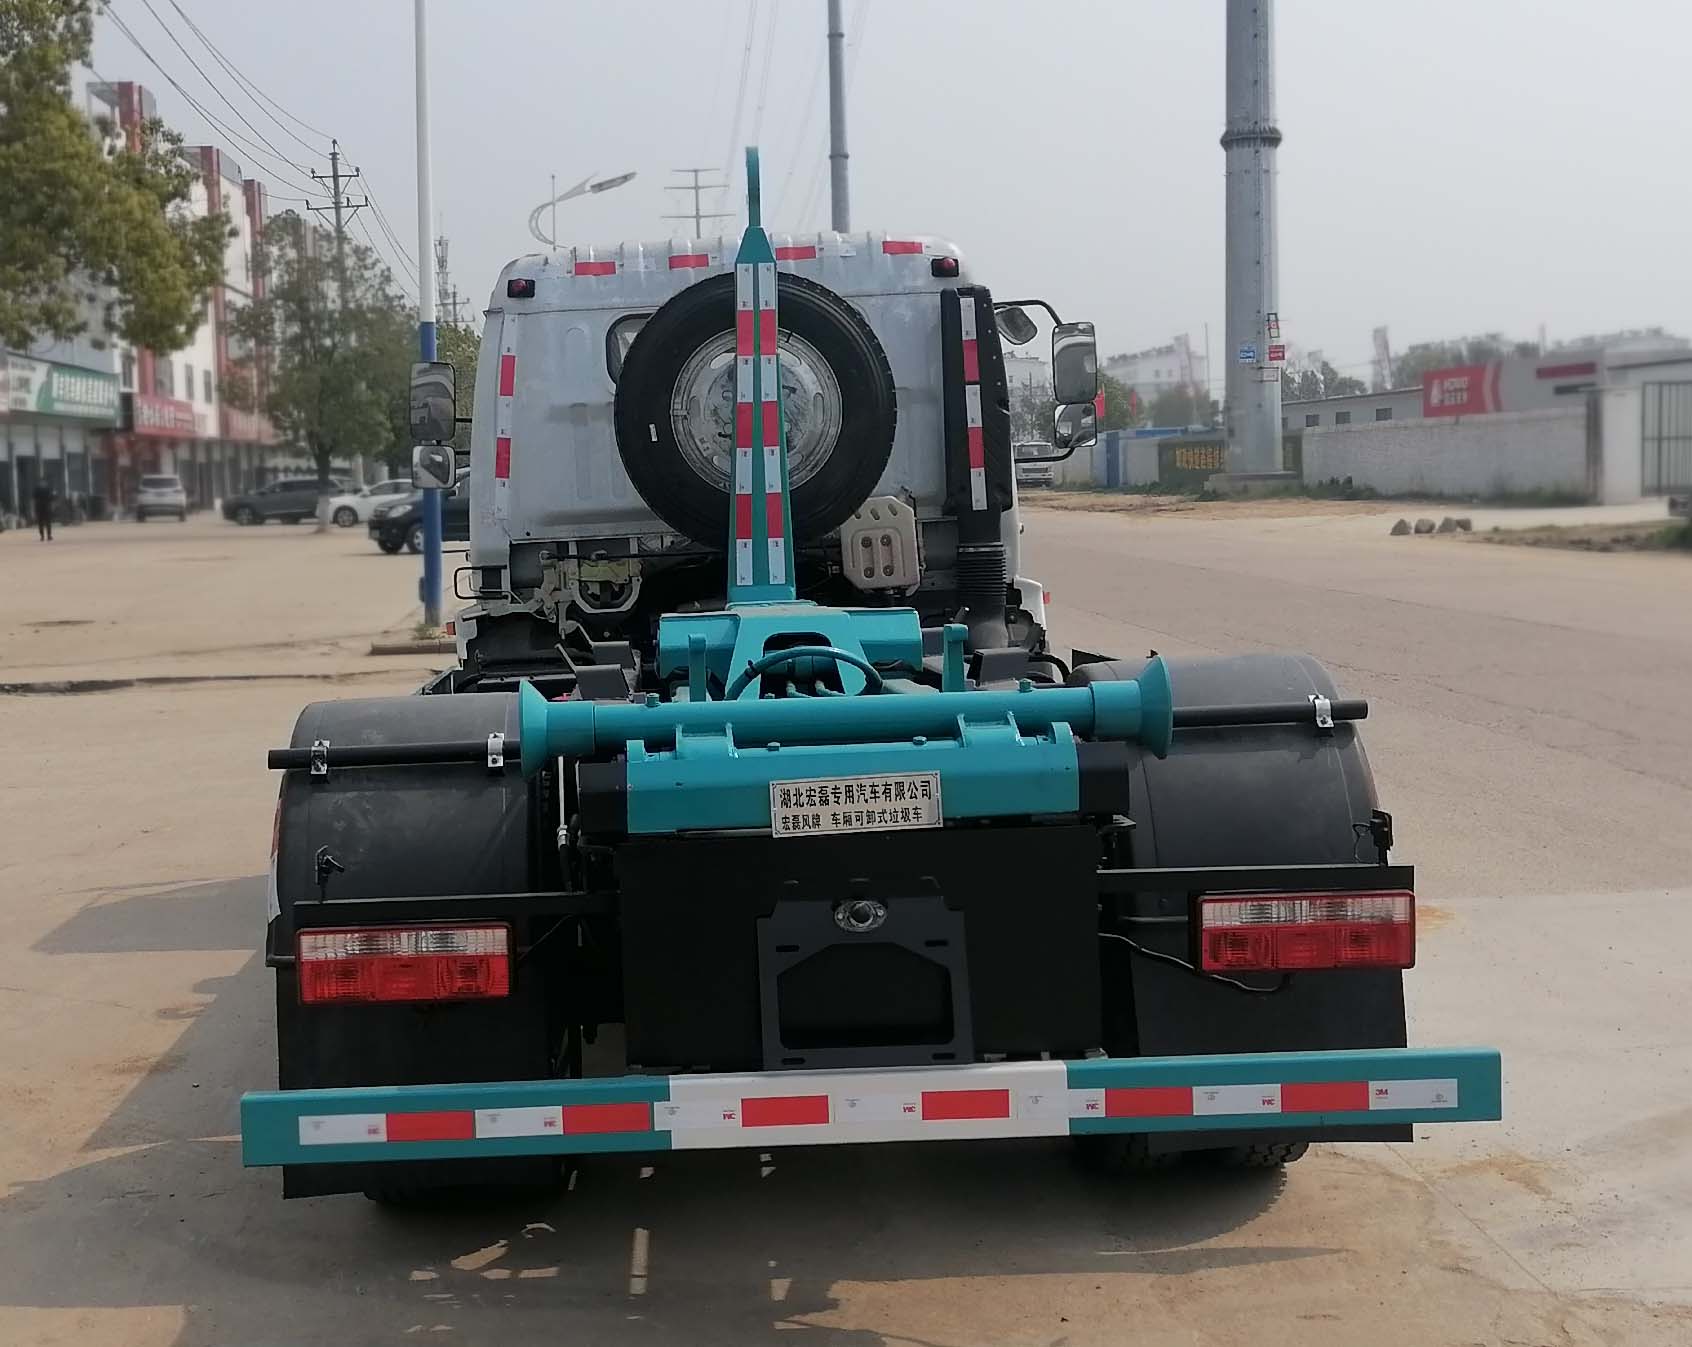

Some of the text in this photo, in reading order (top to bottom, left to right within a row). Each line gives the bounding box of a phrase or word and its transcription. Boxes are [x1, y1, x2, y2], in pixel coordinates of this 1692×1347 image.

[779, 780, 932, 808] 湖北宏磊专用汽车有限公司
[781, 806, 923, 831] 宏磊风牌 车厢可卸式垃圾车
[1375, 1088, 1389, 1096] 3M
